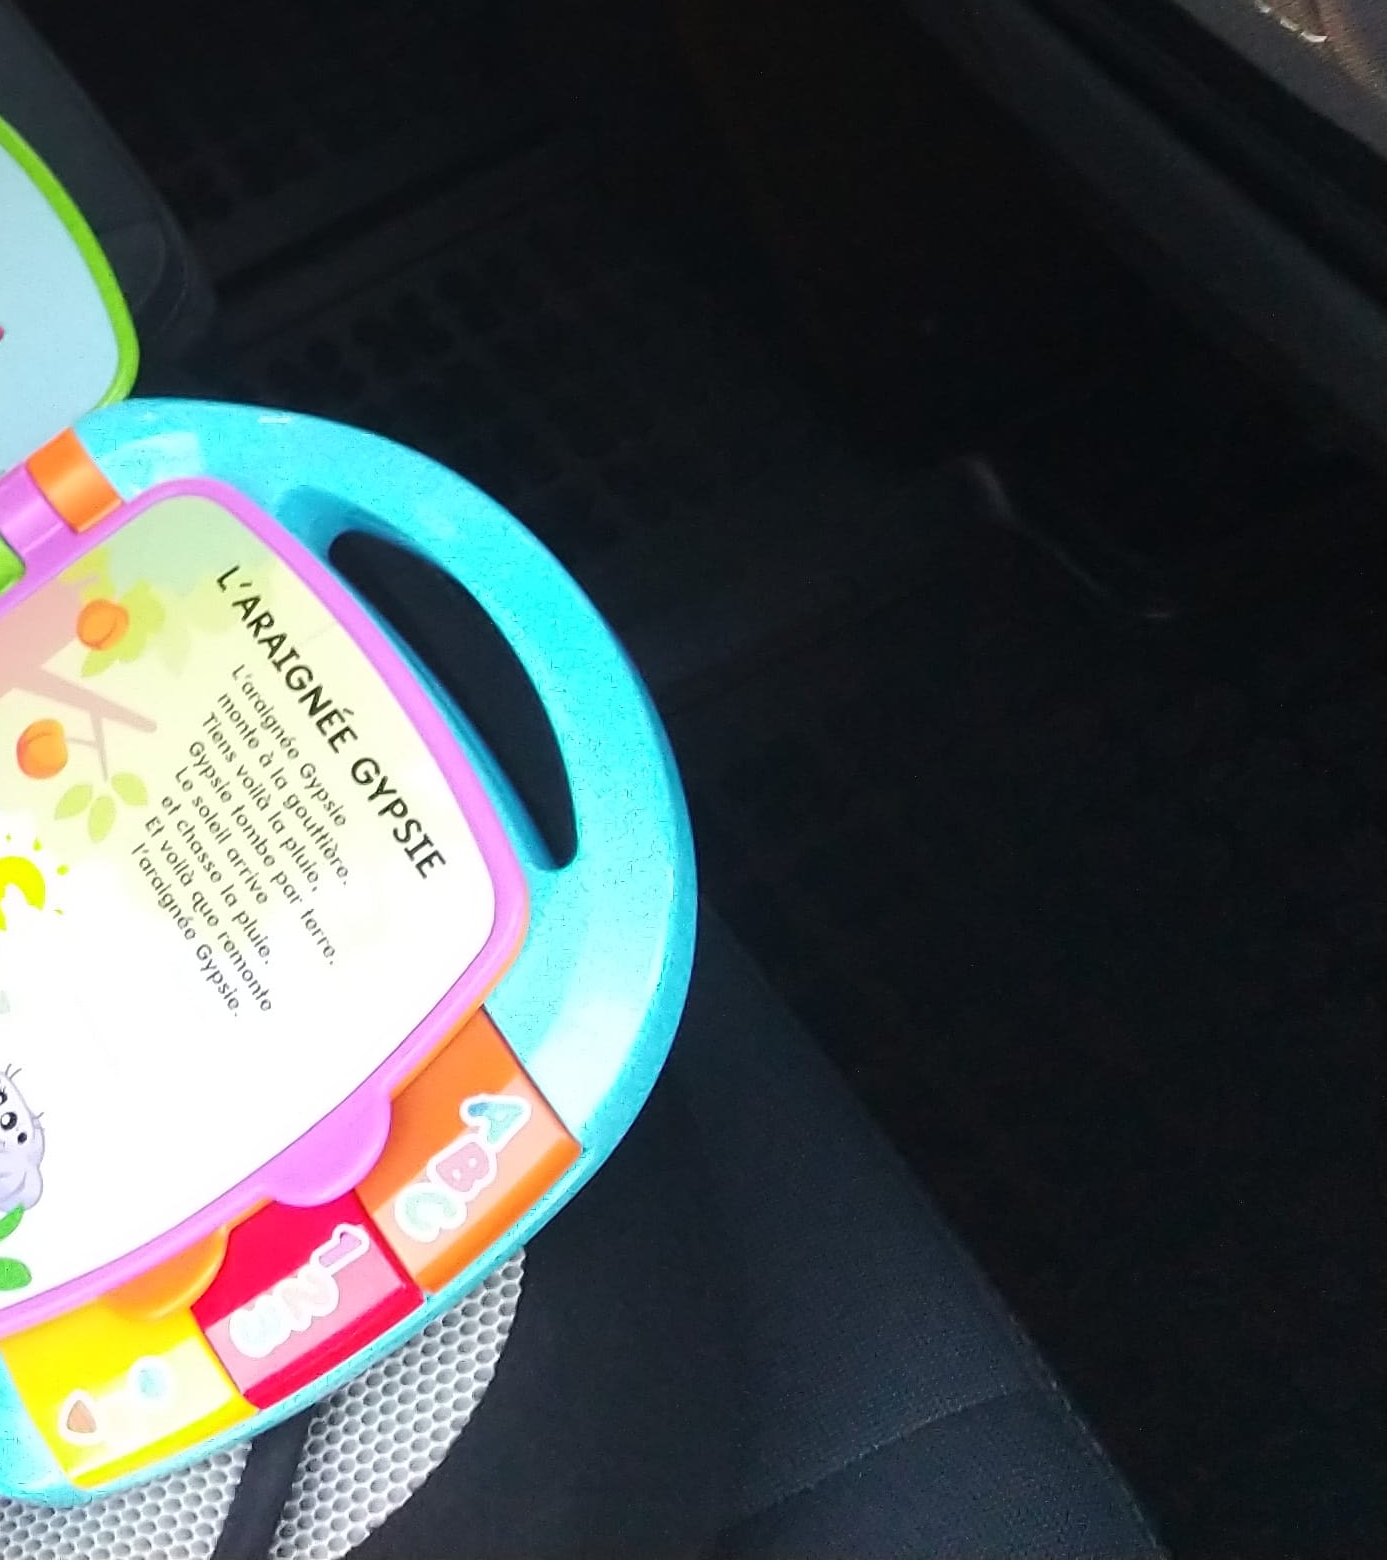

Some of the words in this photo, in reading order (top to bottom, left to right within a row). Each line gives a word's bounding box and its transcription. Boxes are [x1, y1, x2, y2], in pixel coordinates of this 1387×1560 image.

[202, 712, 238, 764] Tiens
[236, 764, 272, 812] voilà
[268, 811, 286, 834] la
[279, 837, 319, 893] pluie,
[216, 565, 359, 754] L'ARAIGNÉE
[351, 756, 447, 879] GYPSIE
[217, 693, 260, 750] monte
[259, 751, 275, 768] à
[270, 767, 289, 791] la
[283, 793, 349, 887] gouttière.
[232, 664, 300, 760] L'araignée
[299, 763, 347, 827] Gypsie
[145, 815, 166, 838] Et
[160, 839, 195, 887] voilà
[192, 891, 220, 927] que
[217, 931, 272, 1011] remonte
[161, 795, 182, 816] et
[176, 819, 222, 883] chasse
[220, 883, 238, 907] la
[231, 910, 270, 965] pluie.
[175, 766, 194, 792] Le
[192, 795, 233, 845] soleil
[227, 847, 268, 904] arrive
[189, 741, 233, 803] Gypsie
[231, 804, 276, 867] tombe
[270, 871, 303, 904] par
[300, 908, 336, 965] terre.
[131, 842, 196, 940] l'araignée
[196, 944, 240, 1017] Gypsie.
[393, 1093, 533, 1243] ABC
